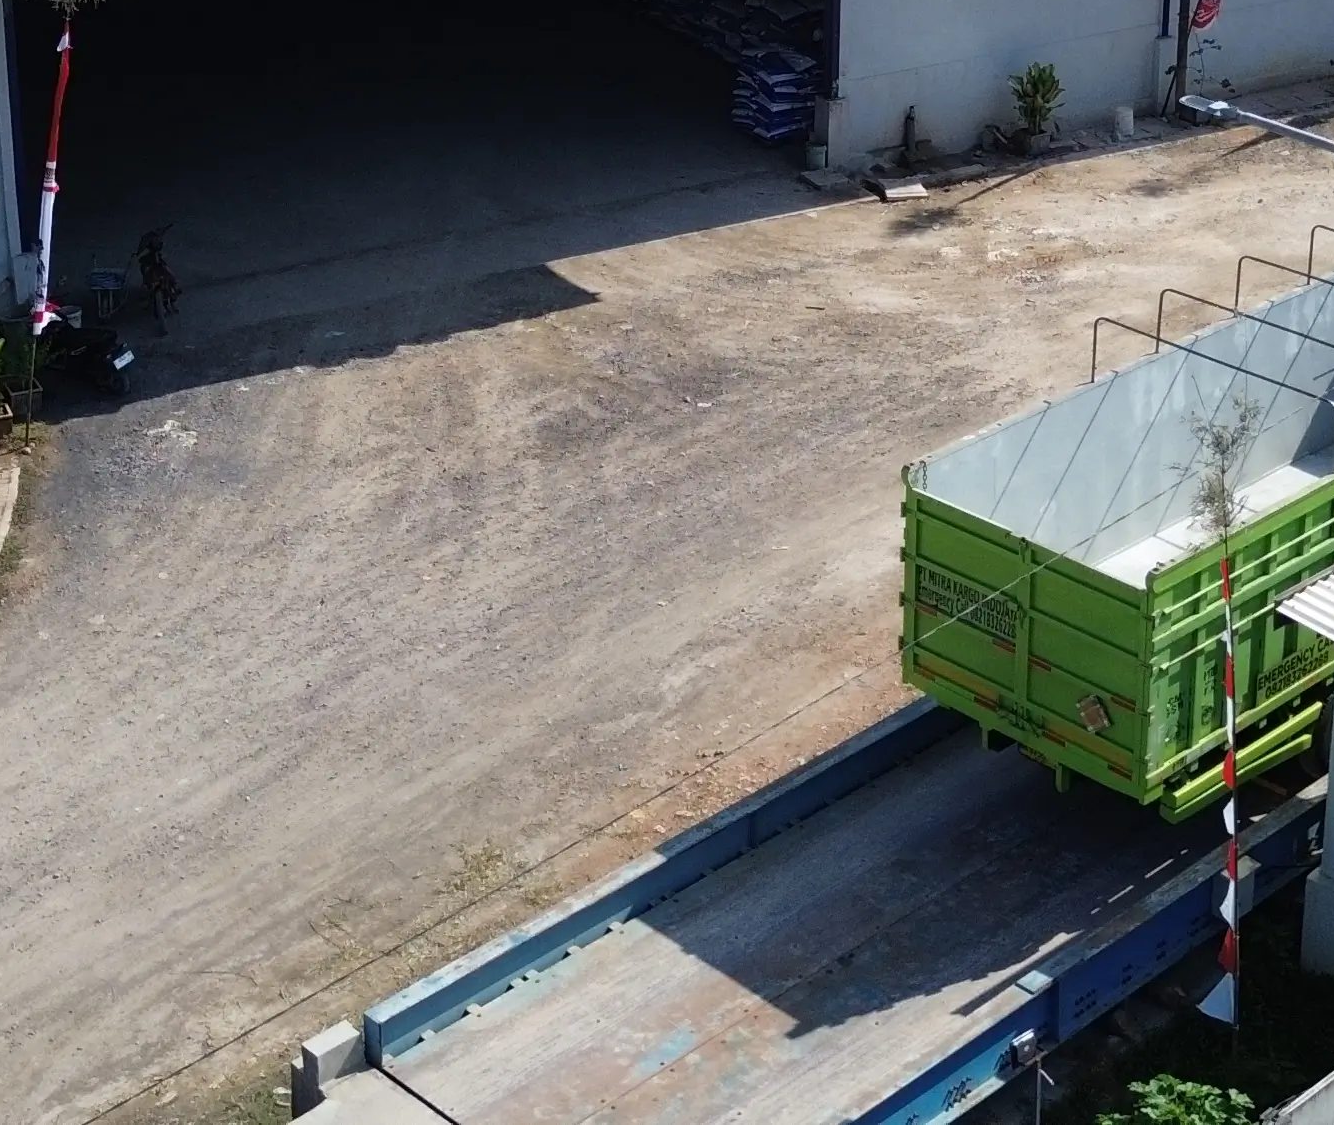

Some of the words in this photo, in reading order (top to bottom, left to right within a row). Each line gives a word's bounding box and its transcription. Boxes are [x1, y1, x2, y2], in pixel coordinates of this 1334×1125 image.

[918, 566, 927, 582] PT
[928, 569, 952, 594] MITRA
[953, 580, 981, 604] KARGO
[1258, 644, 1315, 691] EMERGENCY
